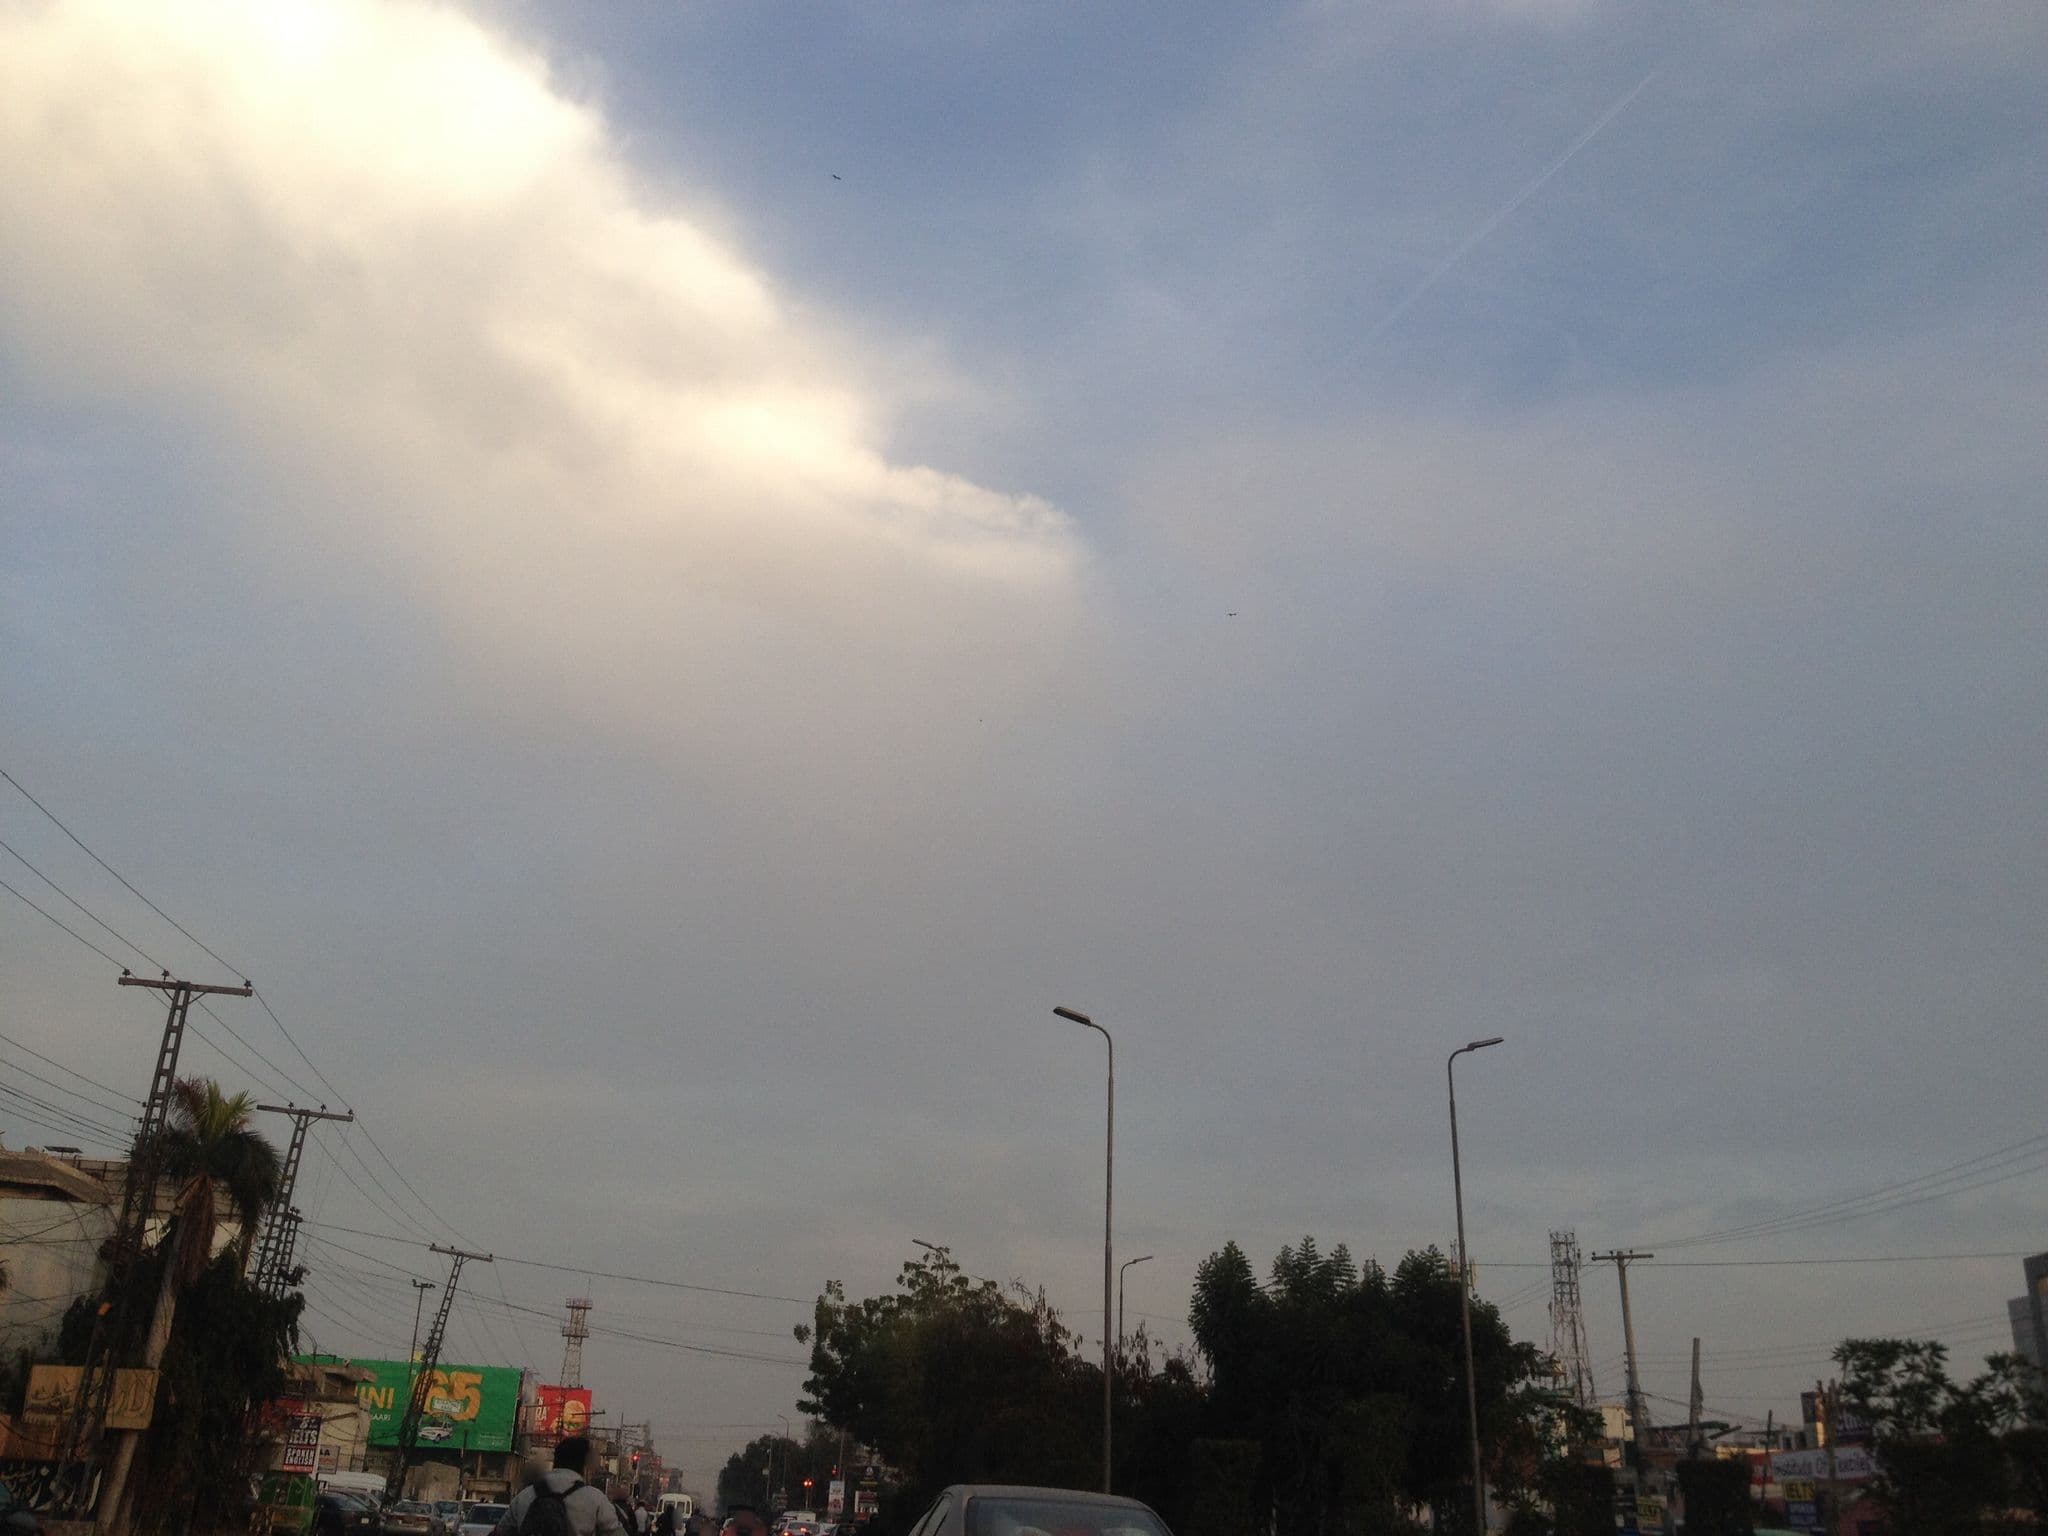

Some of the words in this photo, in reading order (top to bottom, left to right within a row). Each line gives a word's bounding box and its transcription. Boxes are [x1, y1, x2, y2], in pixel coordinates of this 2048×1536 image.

[289, 1429, 318, 1446] IELTS
[287, 1448, 315, 1457] SPOKEN
[285, 1455, 313, 1465] ENGLISH
[1786, 1482, 1816, 1499] IELTS
